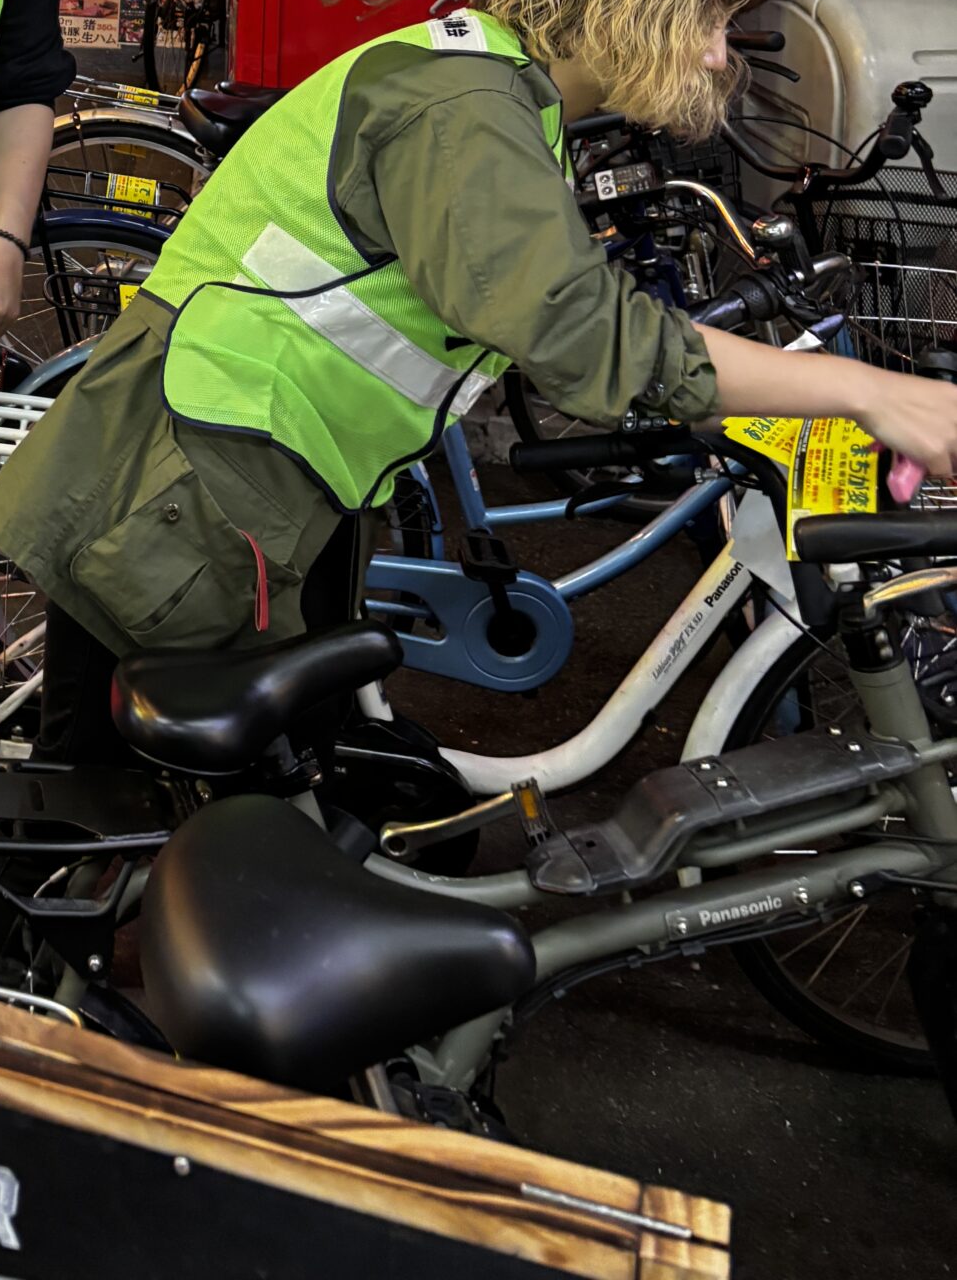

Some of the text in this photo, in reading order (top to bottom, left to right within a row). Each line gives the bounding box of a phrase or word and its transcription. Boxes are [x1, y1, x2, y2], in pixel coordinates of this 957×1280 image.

[81, 32, 117, 44] 生ハム
[698, 894, 783, 927] Panasonic
